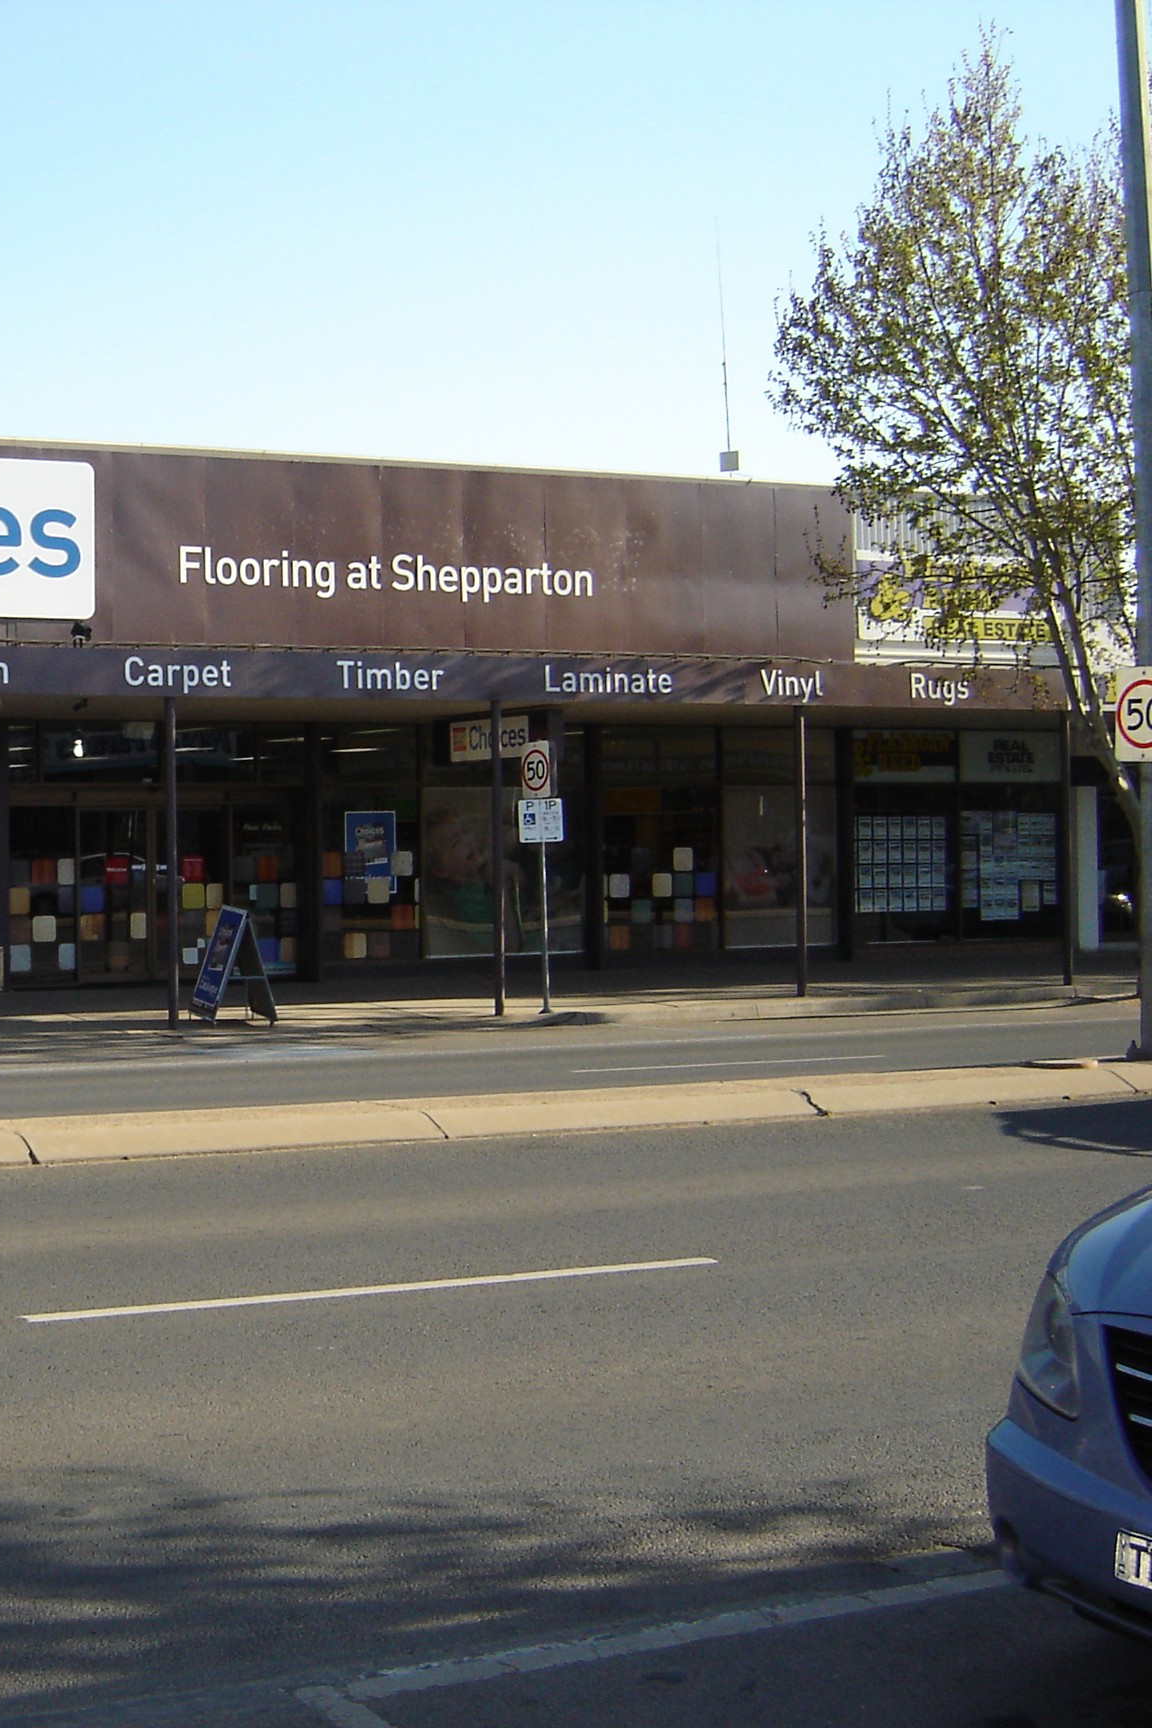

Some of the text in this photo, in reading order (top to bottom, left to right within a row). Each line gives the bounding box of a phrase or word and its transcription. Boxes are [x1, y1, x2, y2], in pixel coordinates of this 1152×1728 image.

[179, 545, 594, 603] Flooring at Shepparton
[124, 656, 232, 694] Carpet
[336, 660, 444, 691] Timber
[545, 664, 673, 694] Laminate
[760, 669, 823, 704] Vinyl
[911, 673, 969, 706] Rugs
[469, 725, 526, 751] Chces
[526, 759, 545, 782] 50
[525, 801, 535, 811] P
[544, 800, 557, 811] 1P
